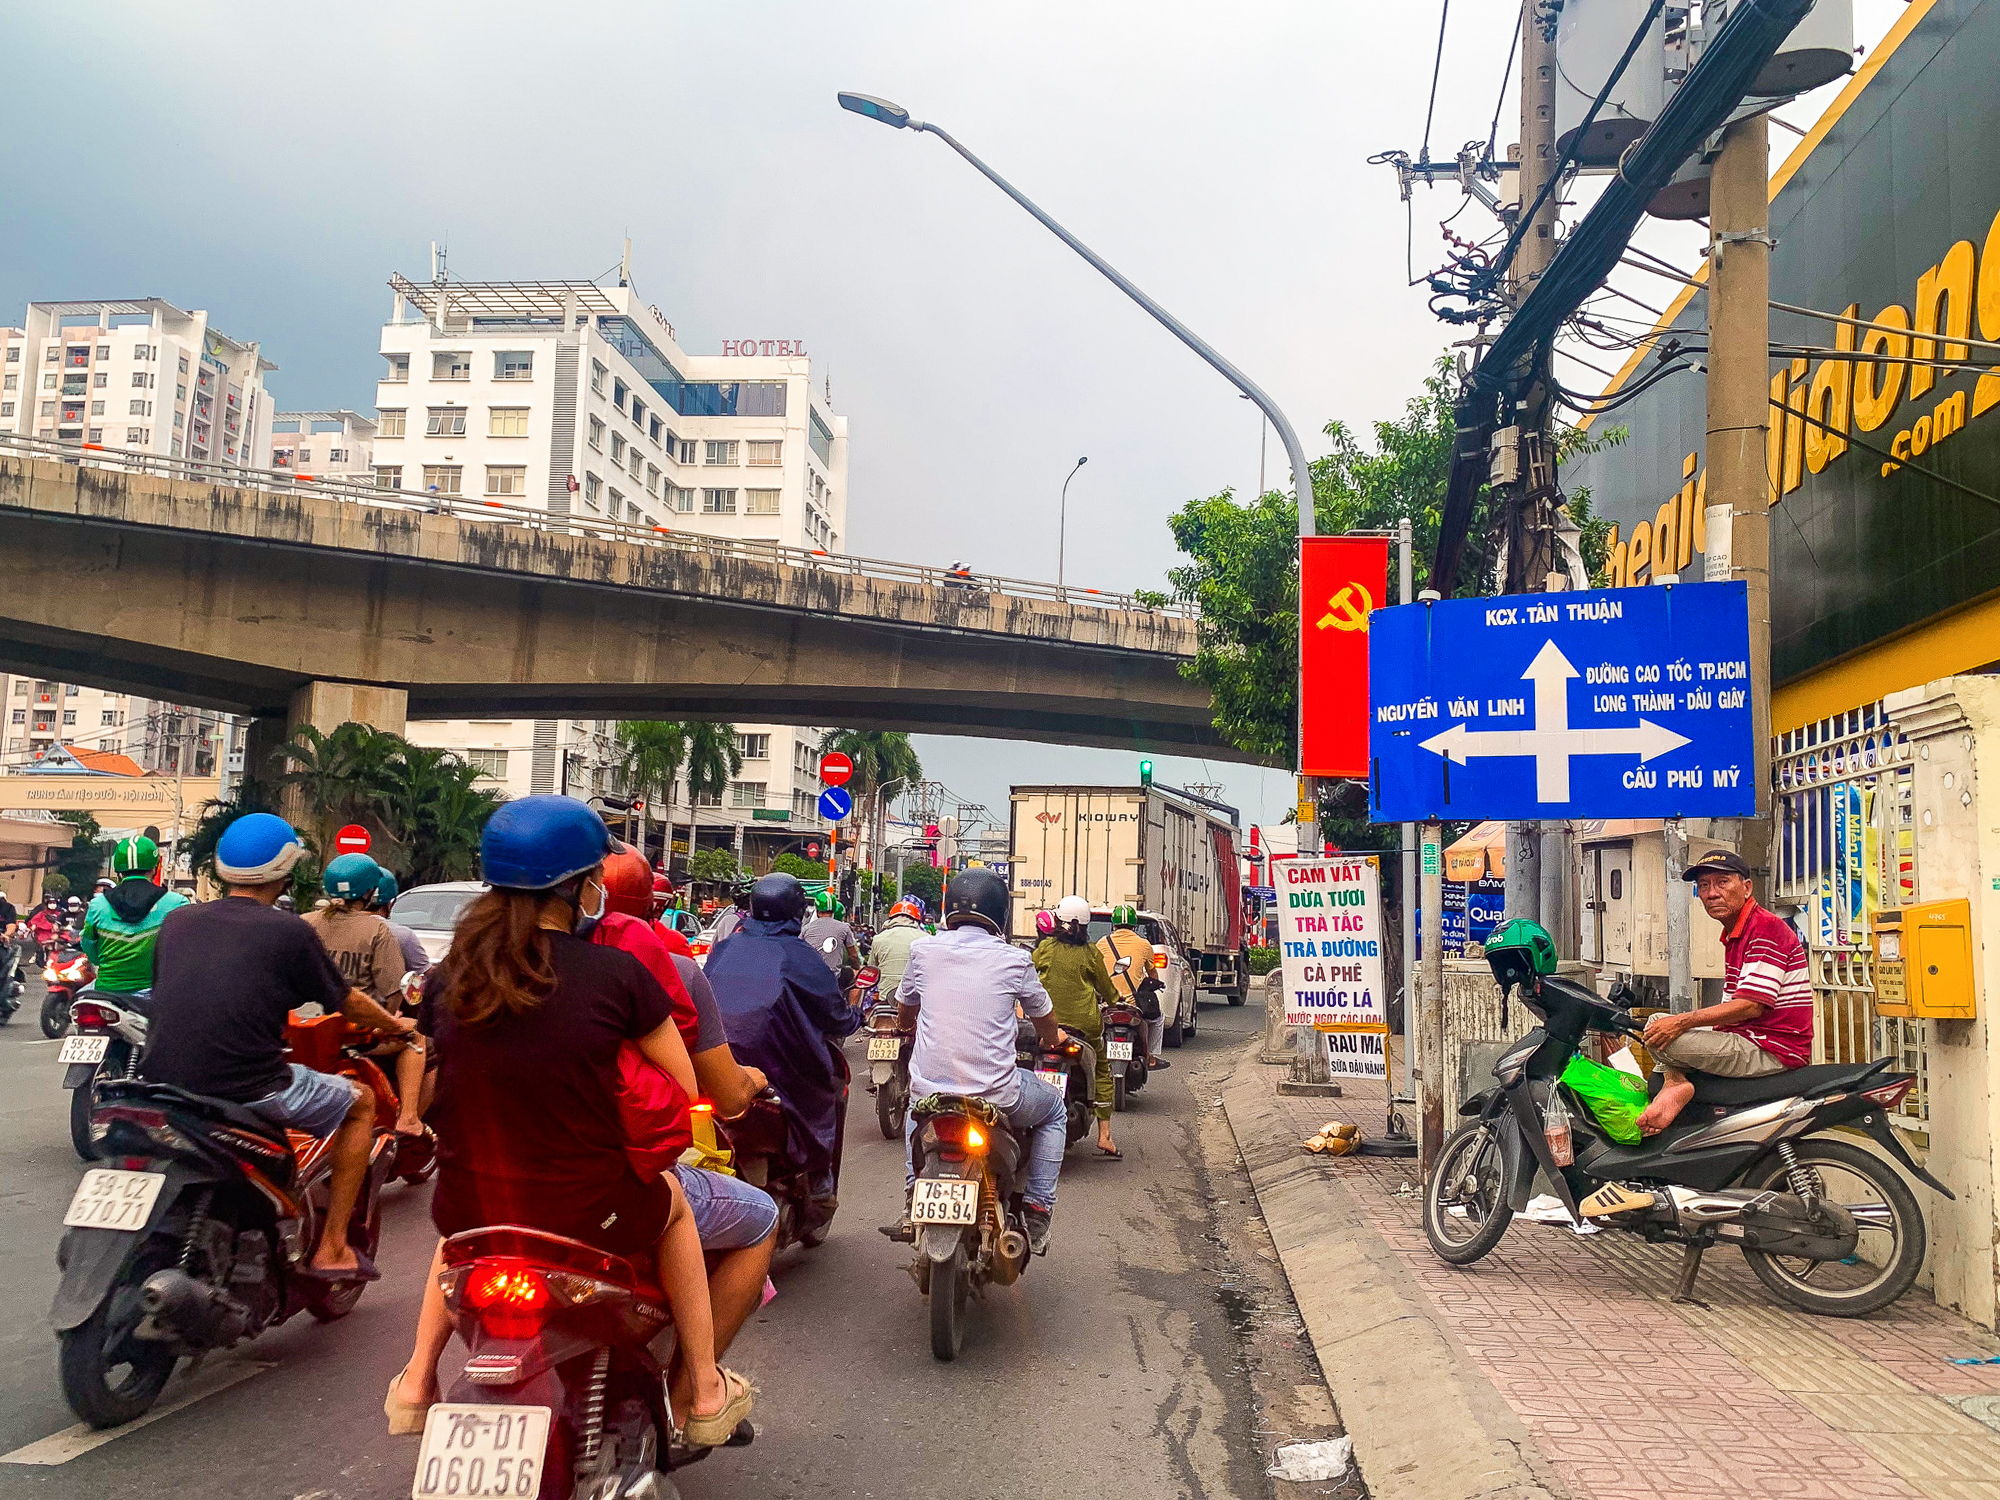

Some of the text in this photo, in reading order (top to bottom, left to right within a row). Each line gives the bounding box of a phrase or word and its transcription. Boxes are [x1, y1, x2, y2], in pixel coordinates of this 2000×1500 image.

[722, 339, 807, 357] HOTEL
[1566, 597, 1623, 624] THUẬN
[1586, 657, 1747, 685] ĐƯỜNG CAO TỐC TP.HCM
[1377, 696, 1525, 722] NGUYỄN VĂN LINH
[1594, 695, 1627, 713] LONG
[1633, 689, 1675, 711] THÀNH
[1687, 686, 1711, 710] DẦU
[1718, 687, 1746, 709] GIÂY
[1622, 765, 1740, 789] CẦU PHÚ MỸ
[1288, 859, 1361, 884] CAM VẮT
[1289, 889, 1324, 908] DỪA
[1328, 889, 1366, 907] TƯƠI
[1295, 910, 1363, 932] TRÀ TẮC
[1284, 937, 1378, 957] TRÀ ĐƯỜNG
[1304, 963, 1362, 982] CÀ PHÊ
[1295, 986, 1373, 1008] THUỐC LÁ
[1287, 1011, 1311, 1023] NƯỚC
[70, 1038, 102, 1049] 59-Z2
[874, 1040, 896, 1049] 47-S1
[1328, 1033, 1384, 1055] RAU MÁ
[1331, 1058, 1386, 1076] SỮA ĐẬU NÀNH
[90, 1174, 150, 1200] 59-C2
[925, 1182, 967, 1200] 76-E1
[915, 1202, 971, 1221] 369.94
[445, 1413, 528, 1451] 76-D1
[423, 1457, 534, 1497] 060.56
